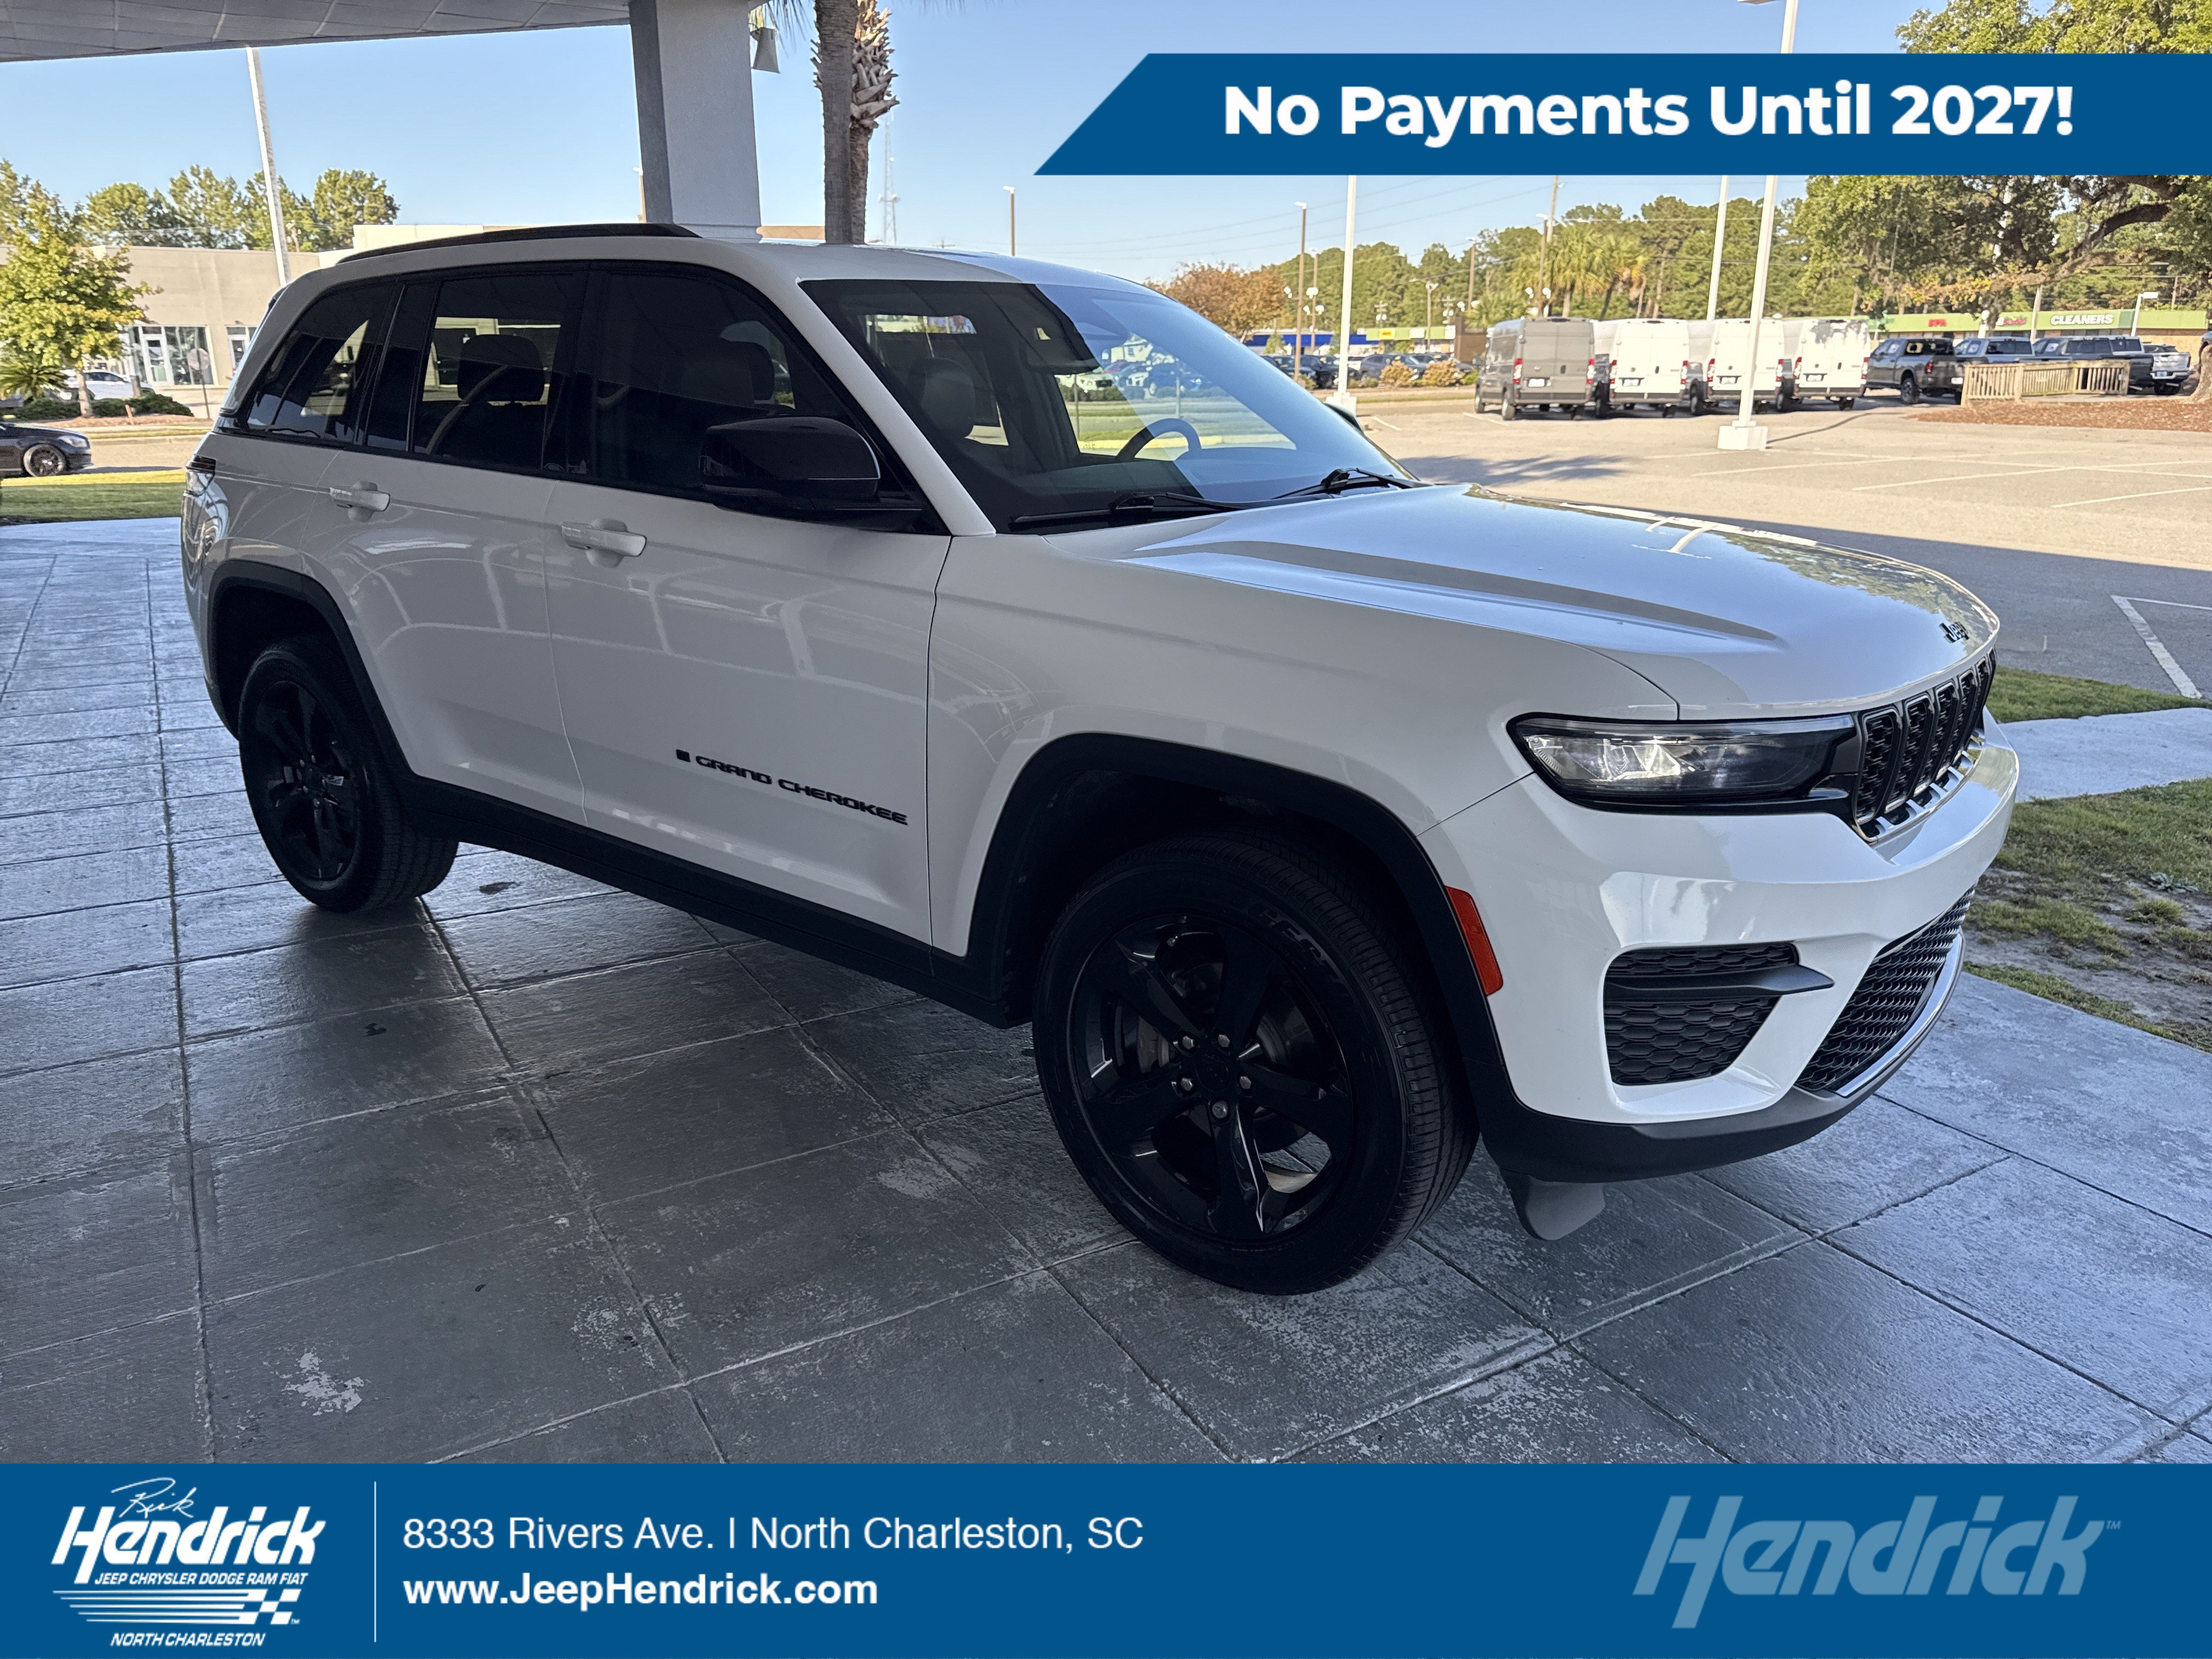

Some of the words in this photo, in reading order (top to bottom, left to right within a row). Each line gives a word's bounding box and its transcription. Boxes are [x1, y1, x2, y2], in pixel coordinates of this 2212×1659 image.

[2050, 314, 2114, 325] CLEANERS
[1939, 622, 1969, 643] Jeep
[696, 755, 772, 785] GRAND
[778, 779, 908, 825] CHEROKEE
